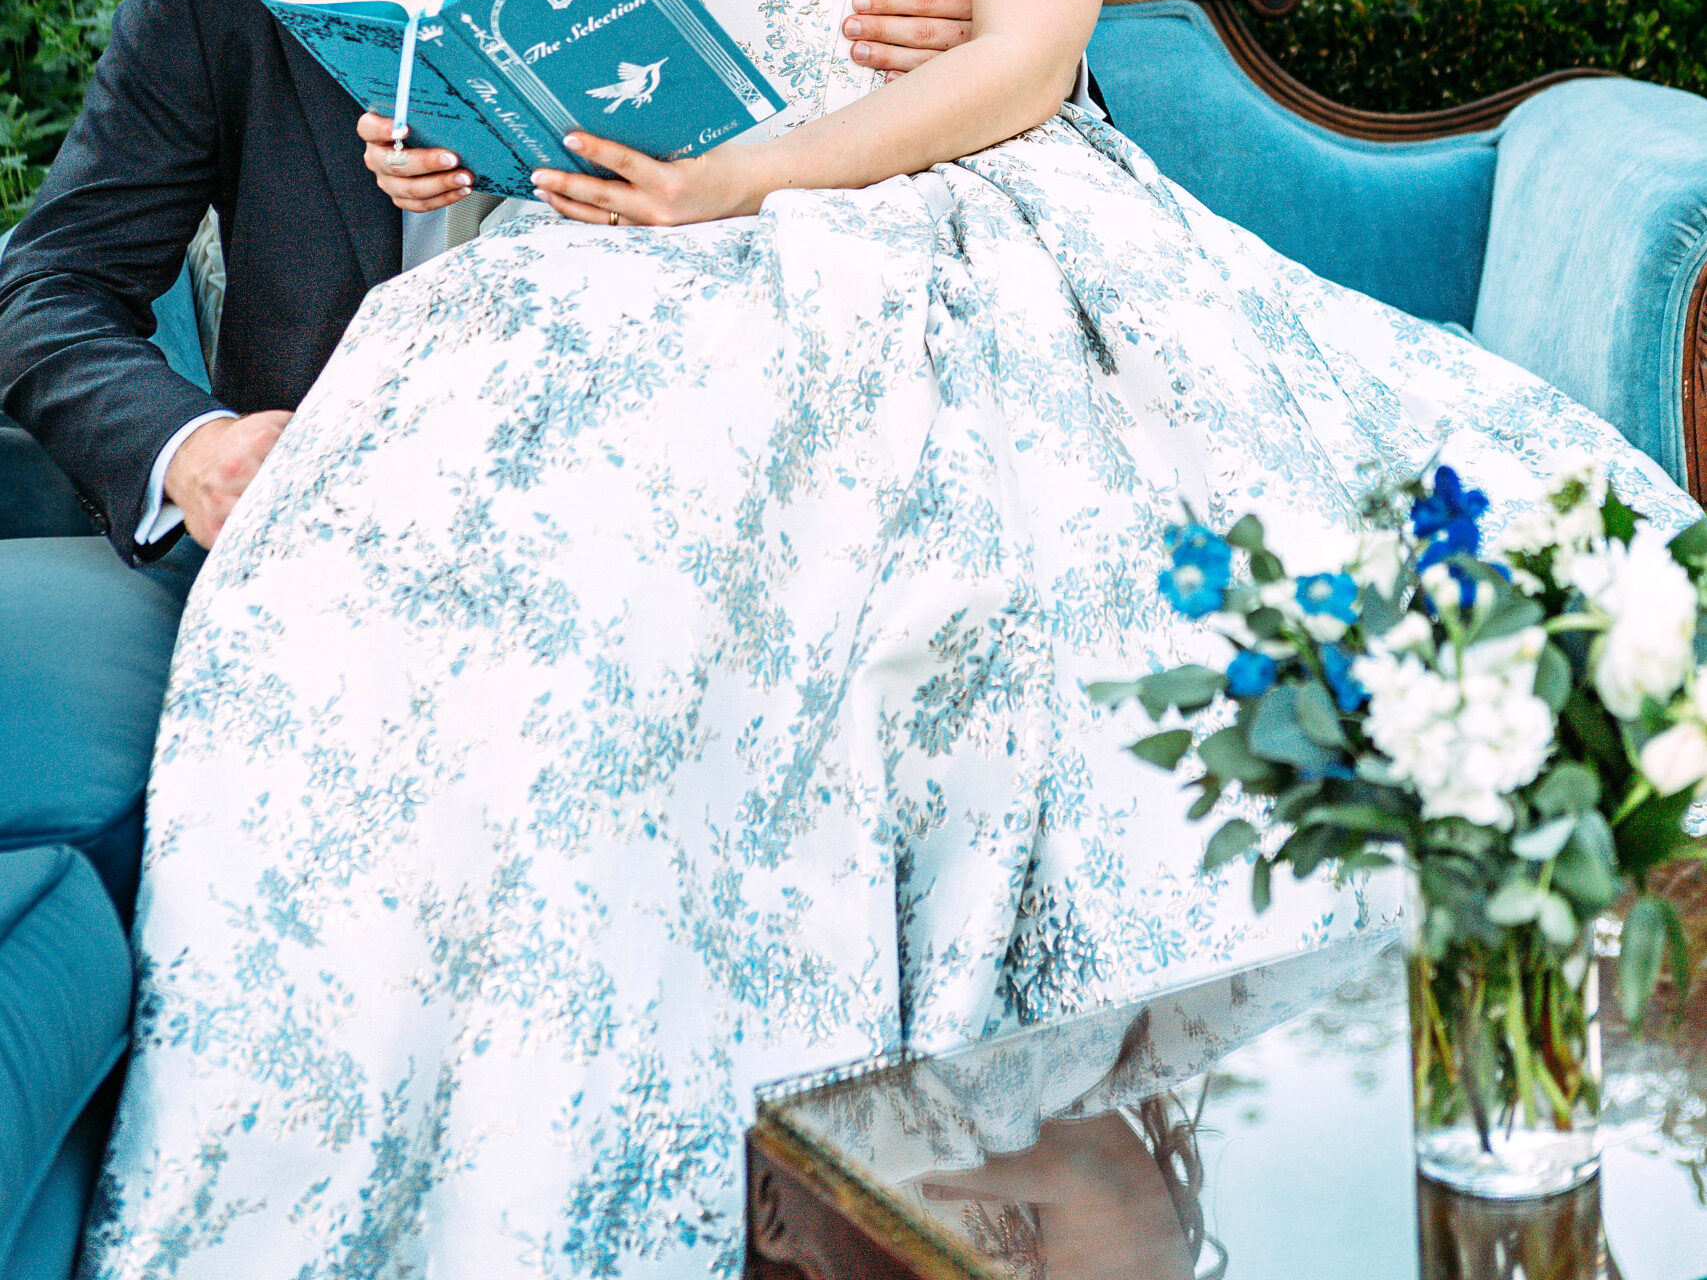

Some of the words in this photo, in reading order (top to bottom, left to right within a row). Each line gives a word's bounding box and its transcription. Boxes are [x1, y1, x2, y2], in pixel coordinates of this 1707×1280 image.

[522, 41, 562, 65] The
[466, 78, 498, 104] The
[494, 106, 552, 162] Selection
